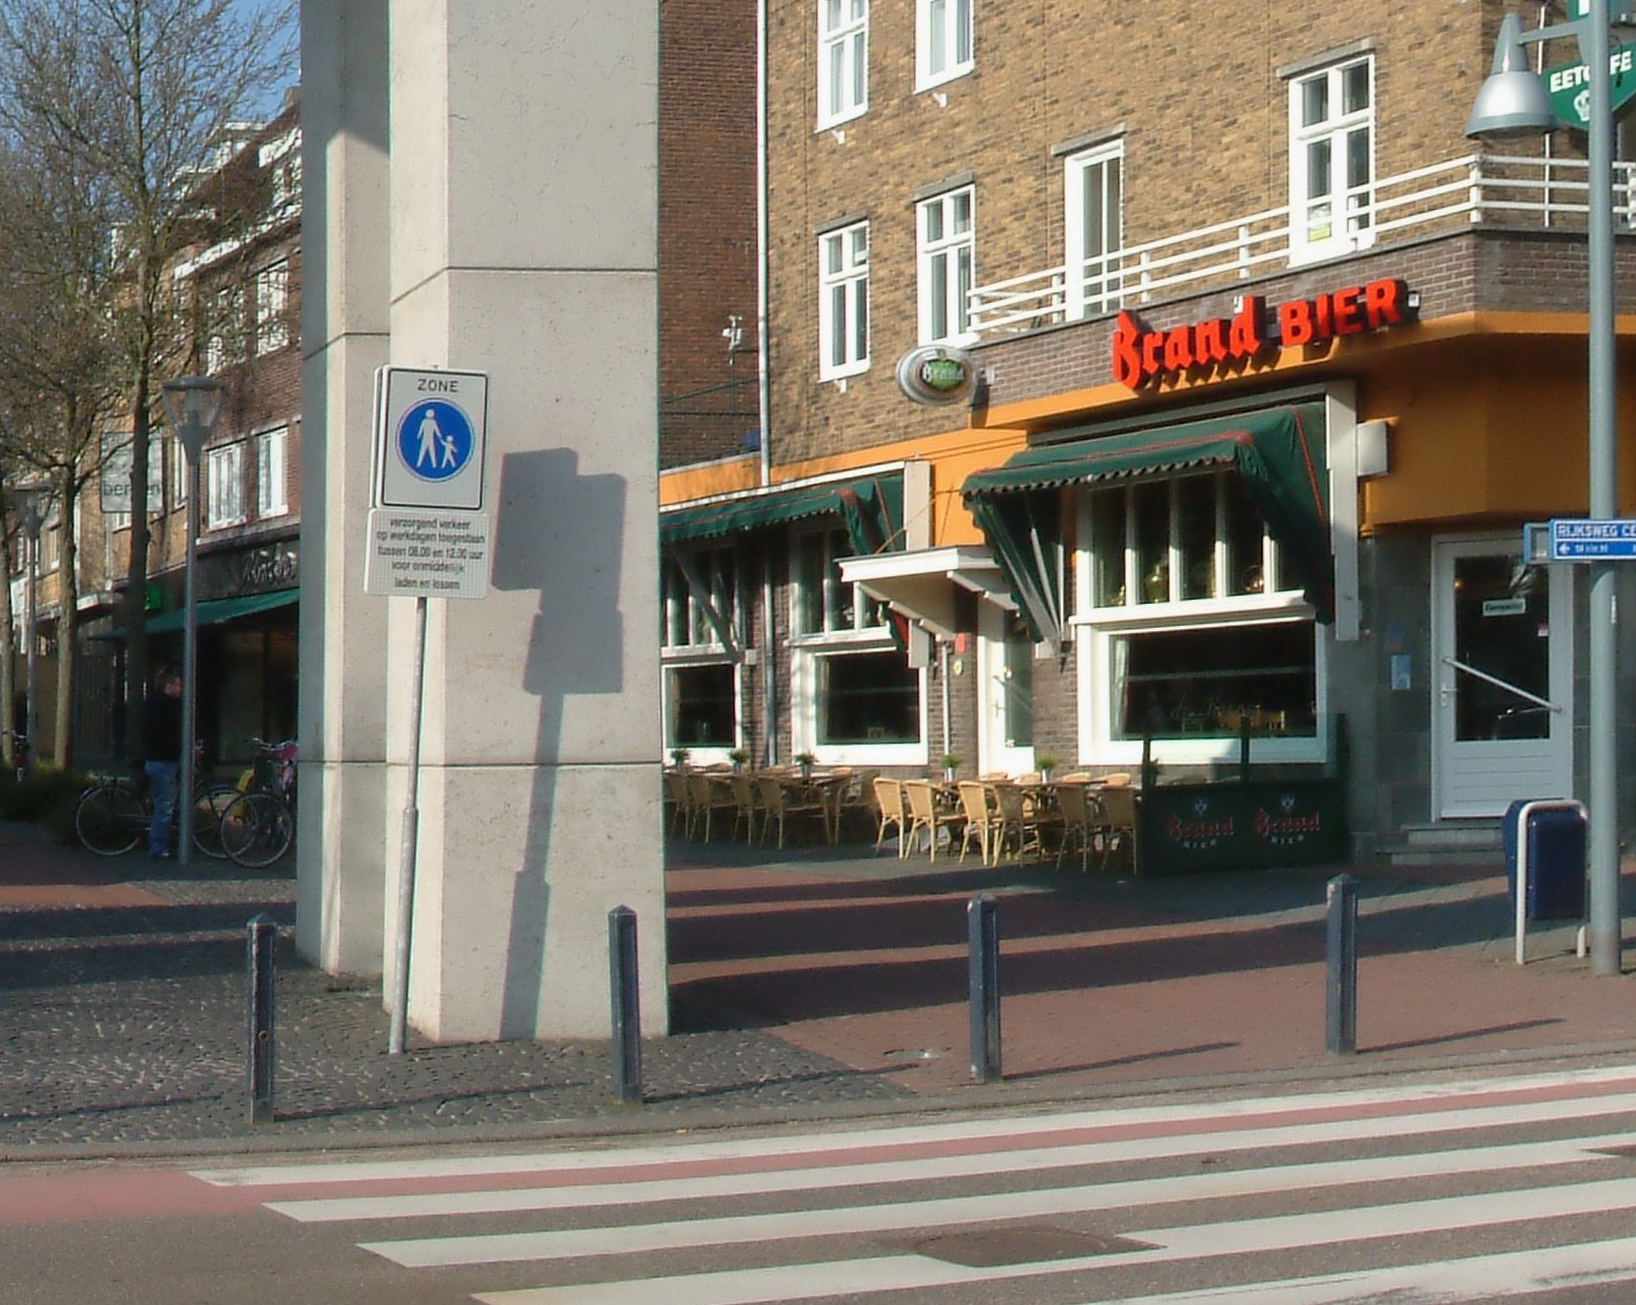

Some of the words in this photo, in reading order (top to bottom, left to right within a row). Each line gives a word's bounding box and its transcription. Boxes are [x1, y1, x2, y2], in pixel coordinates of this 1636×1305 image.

[1550, 50, 1632, 93] EETCFE
[1112, 294, 1261, 391] Brand
[1280, 278, 1402, 347] BIER
[417, 378, 459, 393] ZONE
[439, 521, 471, 530] verkeer
[377, 531, 388, 541] op
[1558, 525, 1618, 537] RIJKSWEG
[378, 546, 406, 555] tussen
[392, 562, 411, 571] voor
[394, 578, 418, 587] laden
[419, 580, 430, 588] en
